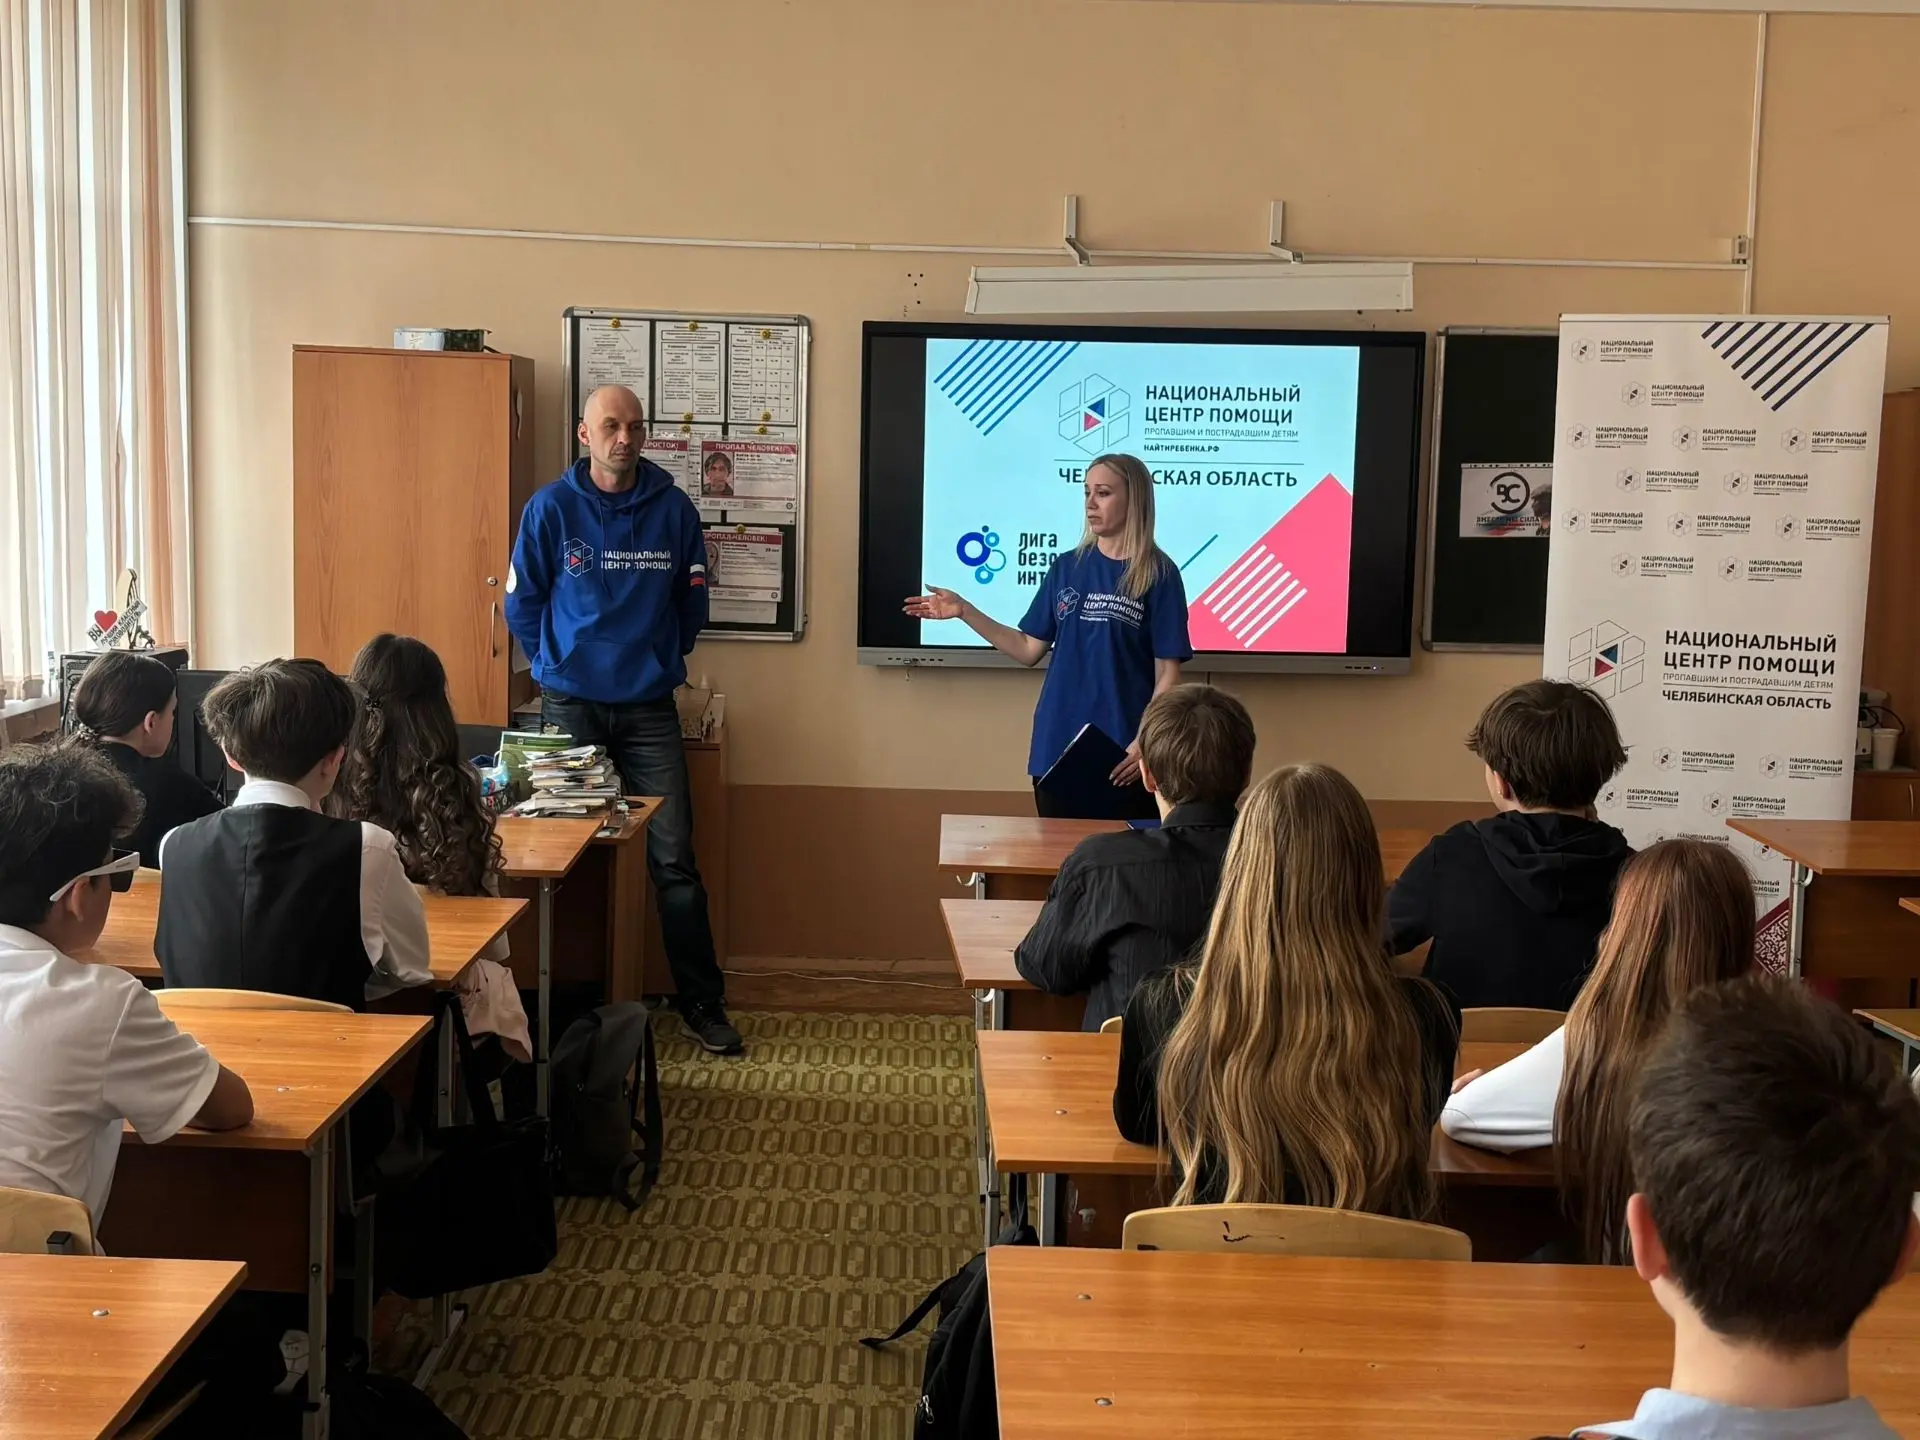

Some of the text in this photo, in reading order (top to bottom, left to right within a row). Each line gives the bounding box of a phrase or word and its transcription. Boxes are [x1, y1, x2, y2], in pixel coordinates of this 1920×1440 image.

[1145, 384, 1300, 402] НАЦИОНАЛЬНЫЙ
[1145, 406, 1293, 424] ЦЕНТР ПОМОЩИ
[1144, 428, 1196, 438] ПРОПАВШИМ
[1205, 428, 1270, 438] ПОСТРАДАВШИМ
[1272, 430, 1298, 438] ДЕТЯМ
[1206, 471, 1298, 486] ОБЛАСТЬ
[1018, 533, 1058, 548] лига
[601, 550, 671, 560] НАЦИОНАЛЬНЫЙ
[601, 561, 672, 570] ЦЕНТР ПОМОЩИ
[1084, 601, 1107, 610] ЦЕНТР
[1108, 602, 1144, 620] ПОМОЩИ
[1665, 630, 1837, 652] НАЦИОНАЛЬНЫЙ
[1664, 652, 1835, 676] ЦЕНТР ПОМОЩИ
[1663, 673, 1719, 683] ПРОПАВШИМ
[1730, 676, 1802, 688] ПОСТРАДАВШИМ
[1804, 680, 1834, 689] ДЕТЯМ
[1662, 690, 1832, 710] ЧЕЛЯБИНСКАЯ ОБЛАСТЬ
